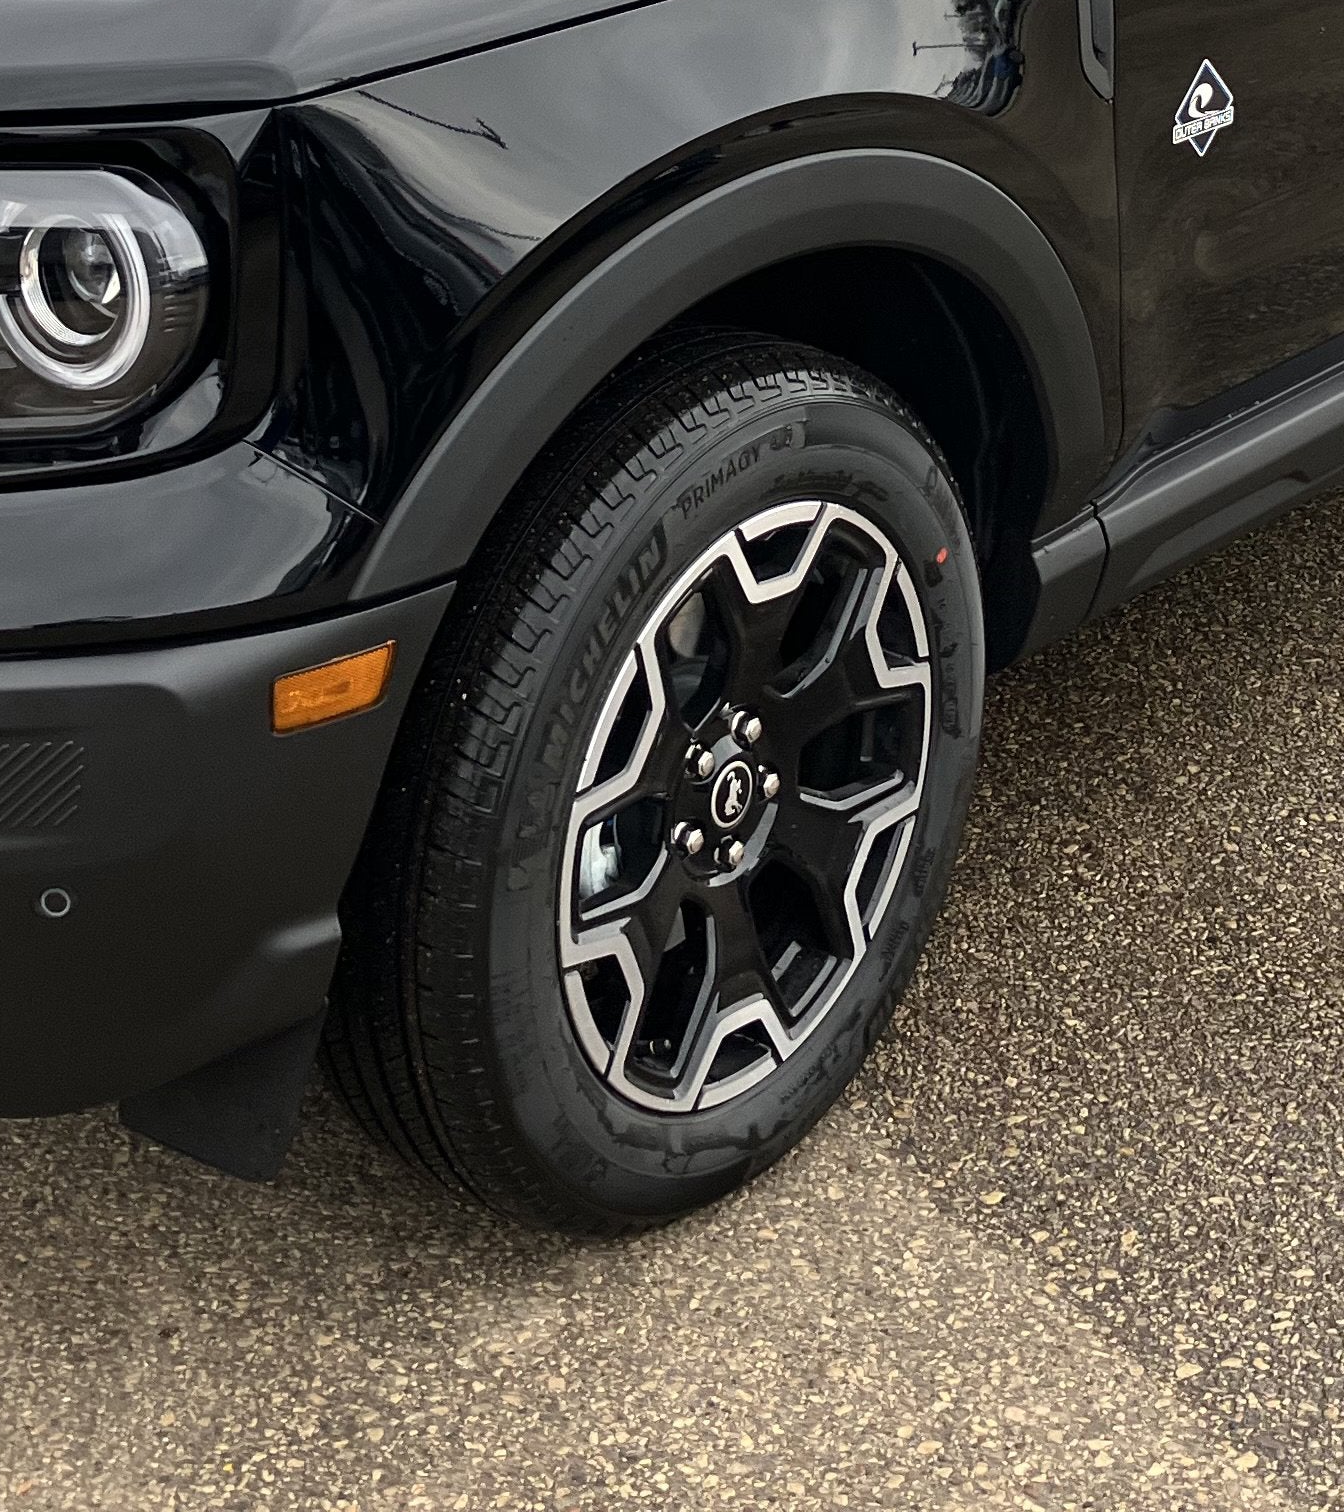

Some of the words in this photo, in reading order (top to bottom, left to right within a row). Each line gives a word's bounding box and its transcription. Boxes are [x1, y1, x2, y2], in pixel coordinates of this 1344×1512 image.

[1175, 119, 1203, 140] OUTER
[1203, 110, 1232, 130] BANKS
[542, 534, 661, 770] MICHELIN
